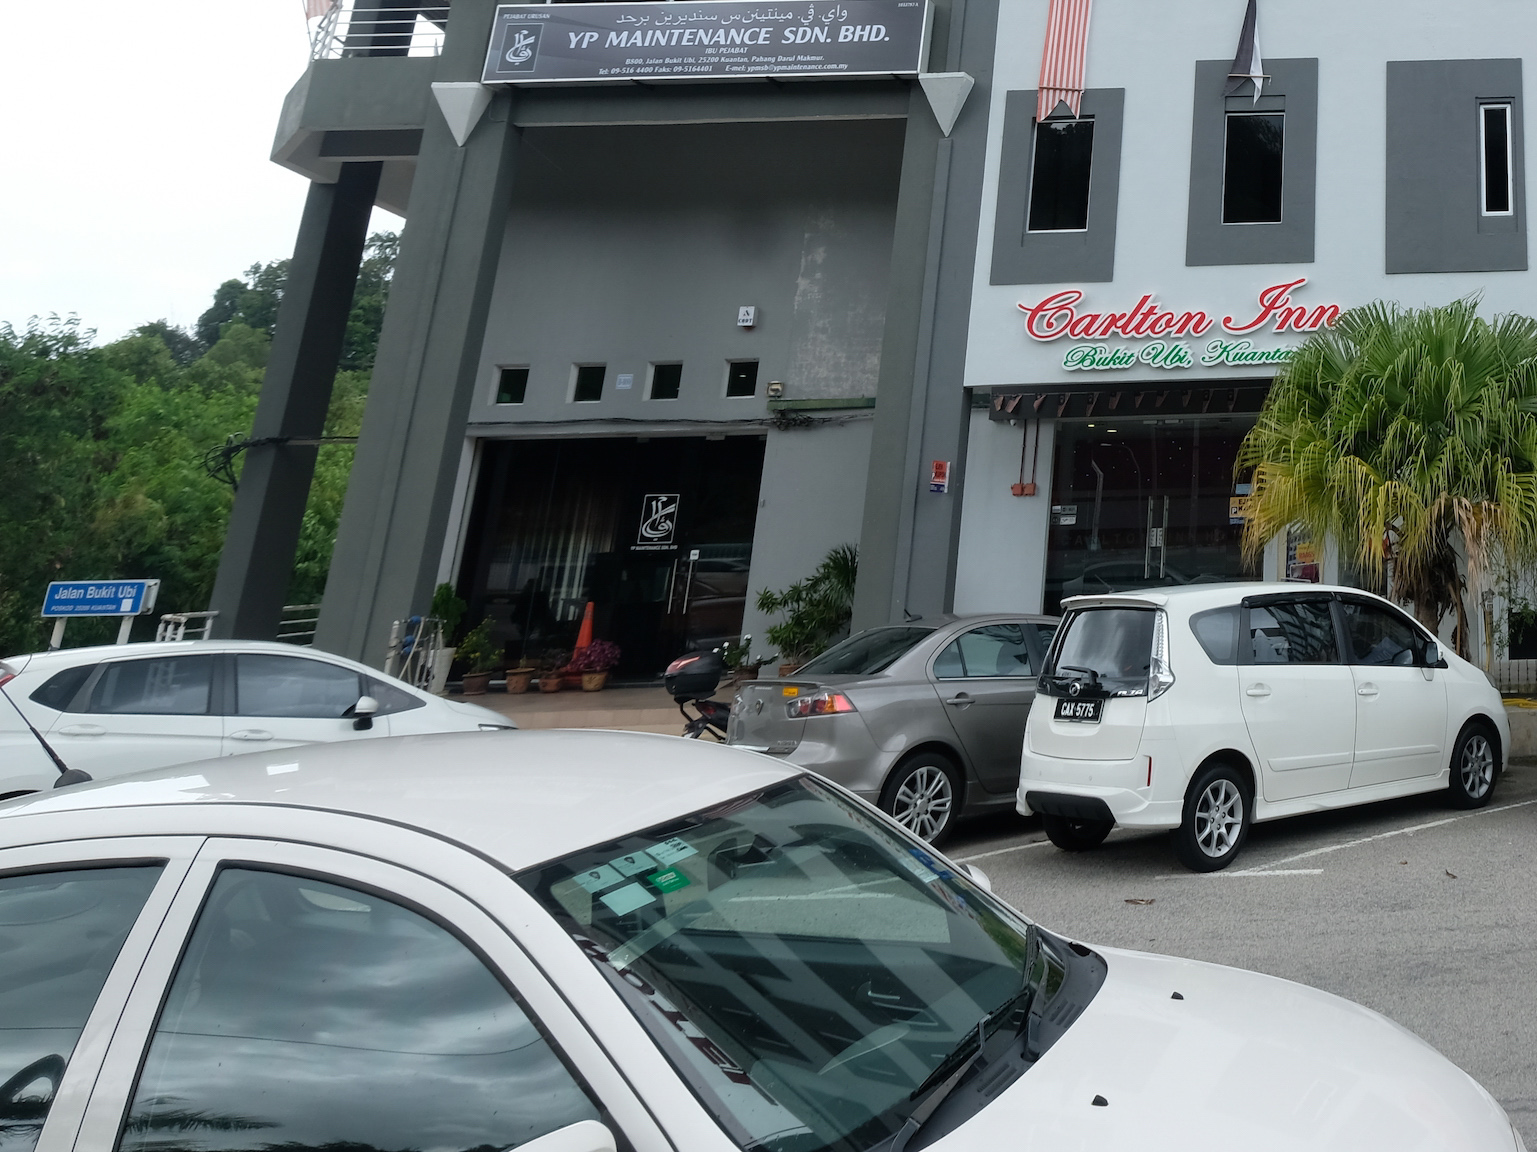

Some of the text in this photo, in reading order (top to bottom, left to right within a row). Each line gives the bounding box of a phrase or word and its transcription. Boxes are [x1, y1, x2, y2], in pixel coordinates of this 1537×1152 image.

[568, 24, 890, 49] YP MAINTENANCE SDN. BHD.
[751, 55, 775, 63] Pahang
[636, 66, 653, 74] 4400
[673, 65, 713, 73] 09-5164401
[1017, 278, 1342, 339] Carlton Inn
[1063, 345, 1136, 369] Bukit
[1140, 342, 1193, 367] Ubi,
[54, 585, 138, 599] Jalan Bukit Ubi
[1061, 702, 1095, 717] CAX 5775
